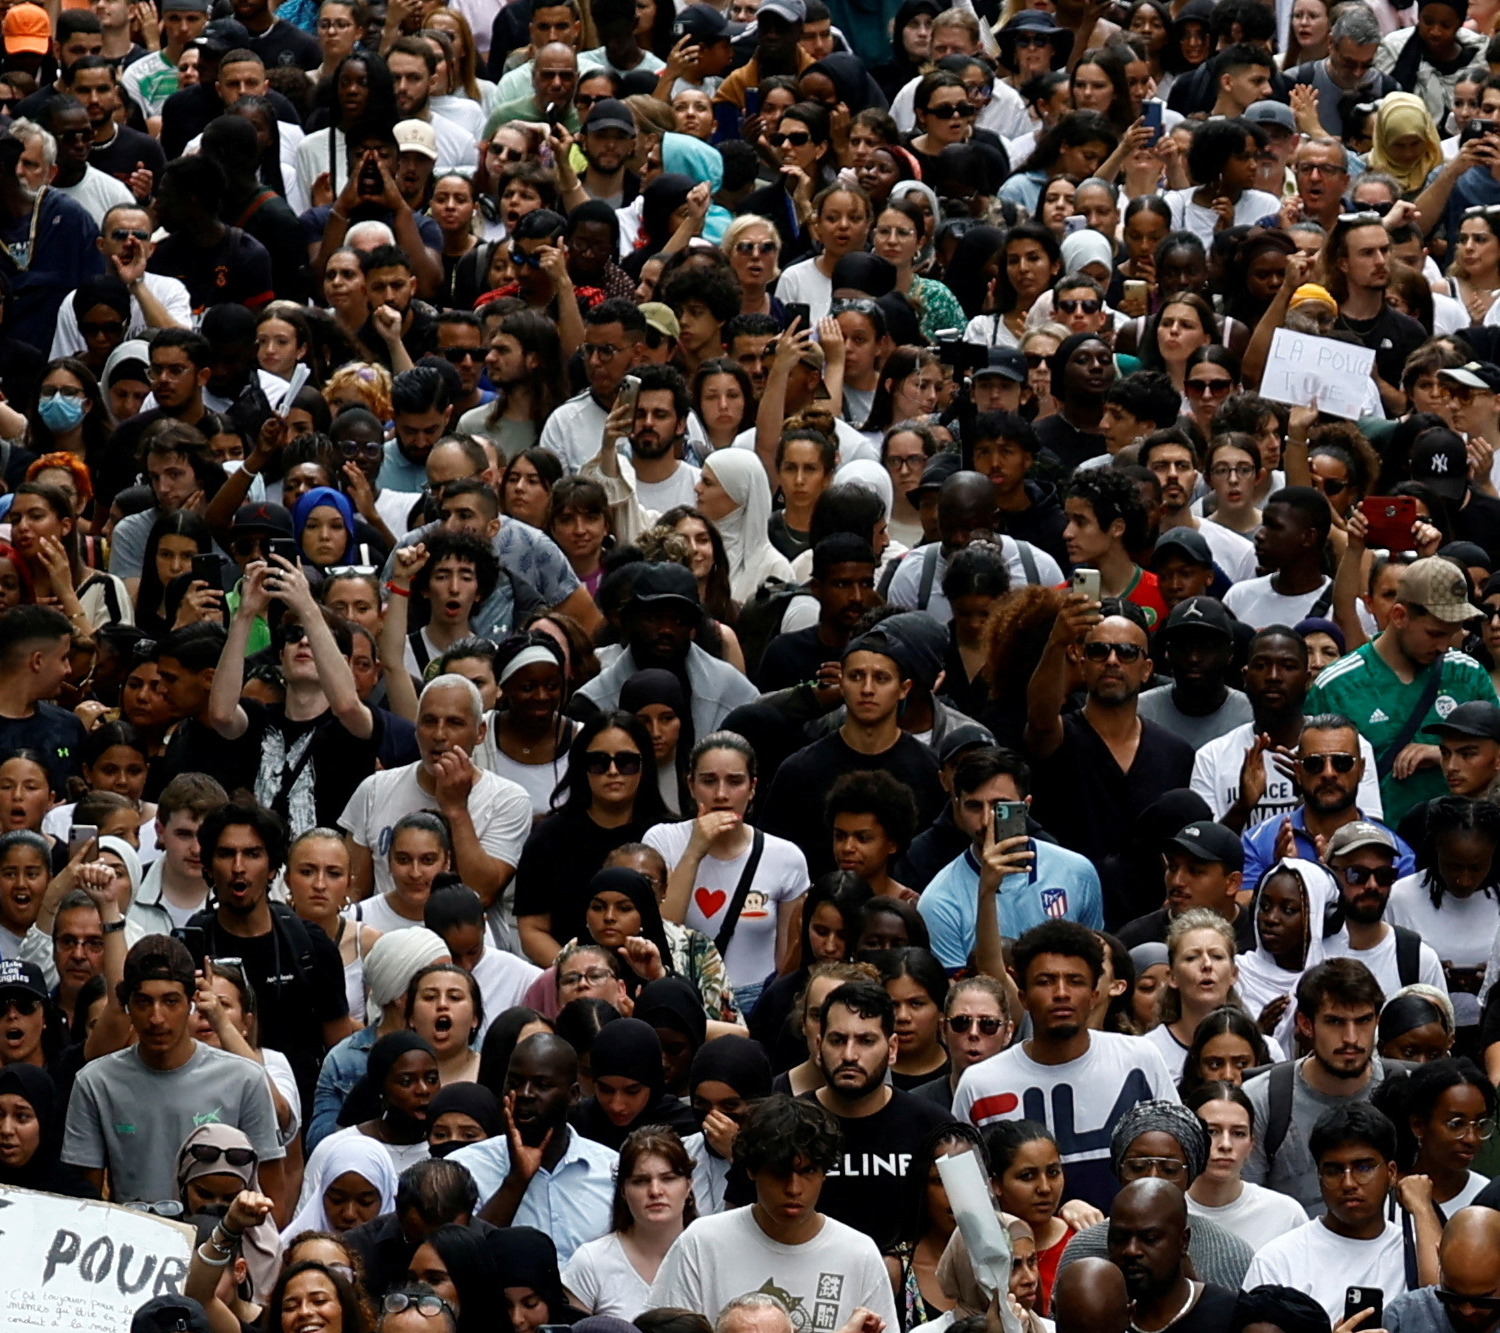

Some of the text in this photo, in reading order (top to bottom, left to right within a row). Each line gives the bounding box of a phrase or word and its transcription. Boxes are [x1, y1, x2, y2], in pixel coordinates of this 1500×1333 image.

[1274, 333, 1375, 379] LA POLICE
[1227, 781, 1289, 804] JUICE
[41, 1227, 189, 1296] POUR
